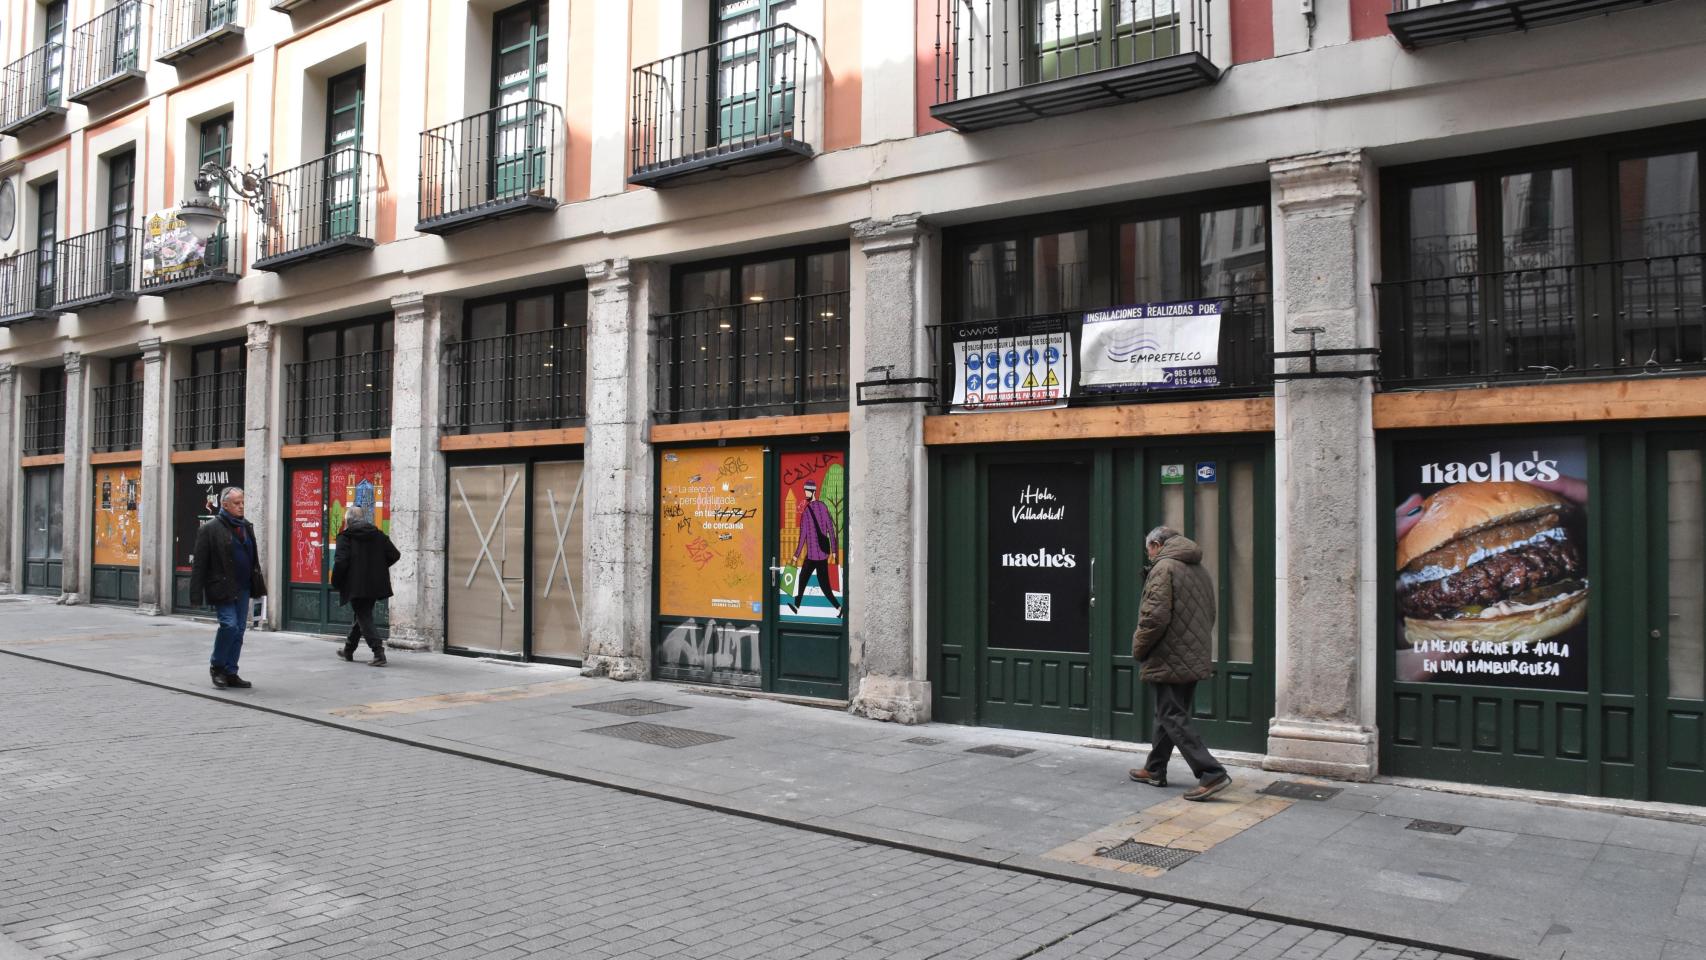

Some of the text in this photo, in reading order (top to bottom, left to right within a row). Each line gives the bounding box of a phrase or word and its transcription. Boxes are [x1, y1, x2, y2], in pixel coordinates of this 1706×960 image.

[1087, 303, 1217, 322] INSTALACIONES REALIZADAS POR:
[1130, 351, 1202, 364] EMPRETELCO
[1174, 369, 1187, 377] 983
[1188, 369, 1202, 377] 844
[1203, 376, 1218, 384] 409
[1012, 505, 1065, 524] Valladolid!
[703, 521, 713, 529] de
[1002, 547, 1076, 568] nache's
[1414, 640, 1570, 658] LA MEJOR CARNE DE ÁVILA
[1423, 659, 1560, 676] EN UNA HAMBURGUESA
